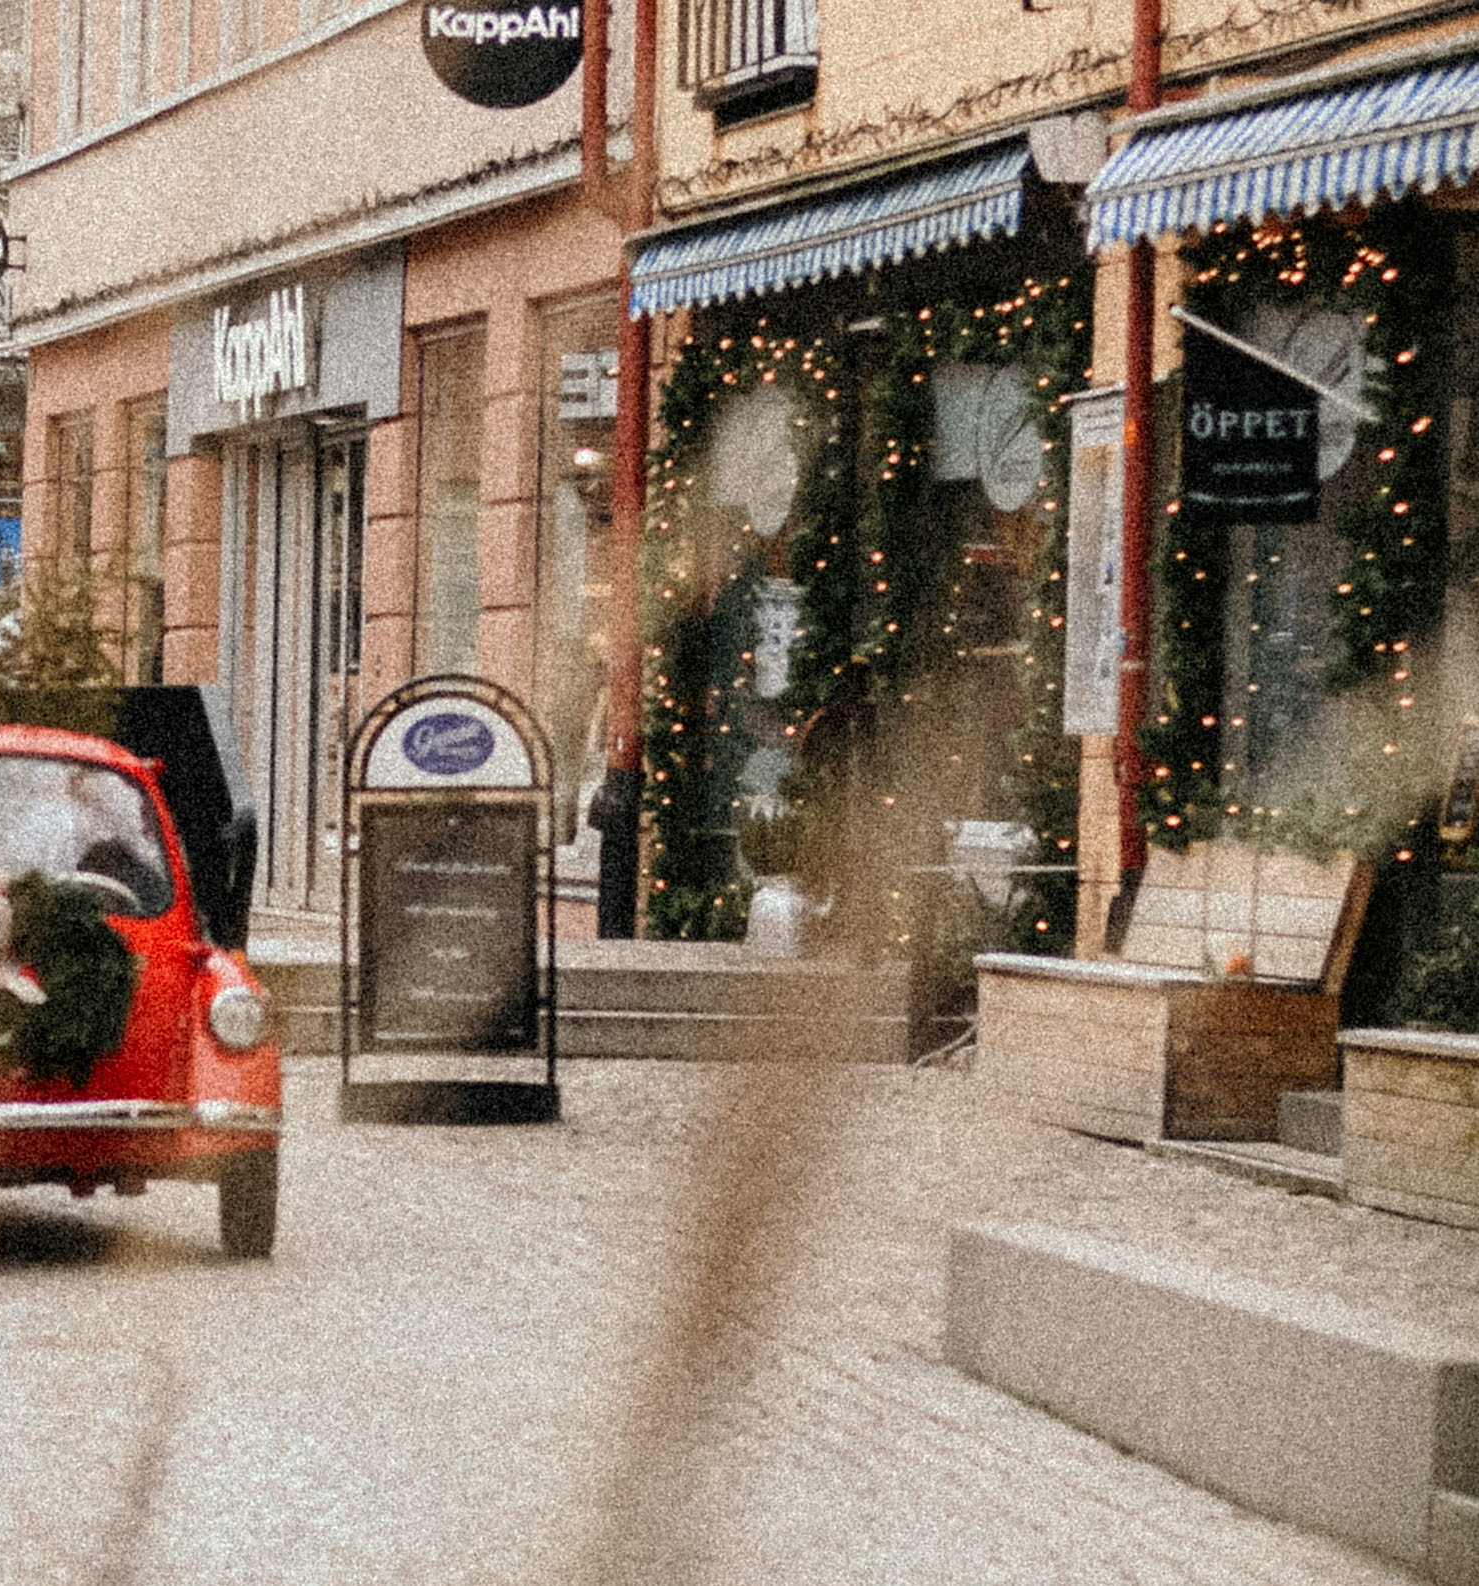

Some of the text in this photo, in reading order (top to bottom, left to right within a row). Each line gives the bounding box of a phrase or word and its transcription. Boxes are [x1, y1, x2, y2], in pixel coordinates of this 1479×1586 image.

[429, 5, 580, 45] KappAhl
[212, 284, 305, 421] KappAhl
[1189, 401, 1312, 440] ÖPPET
